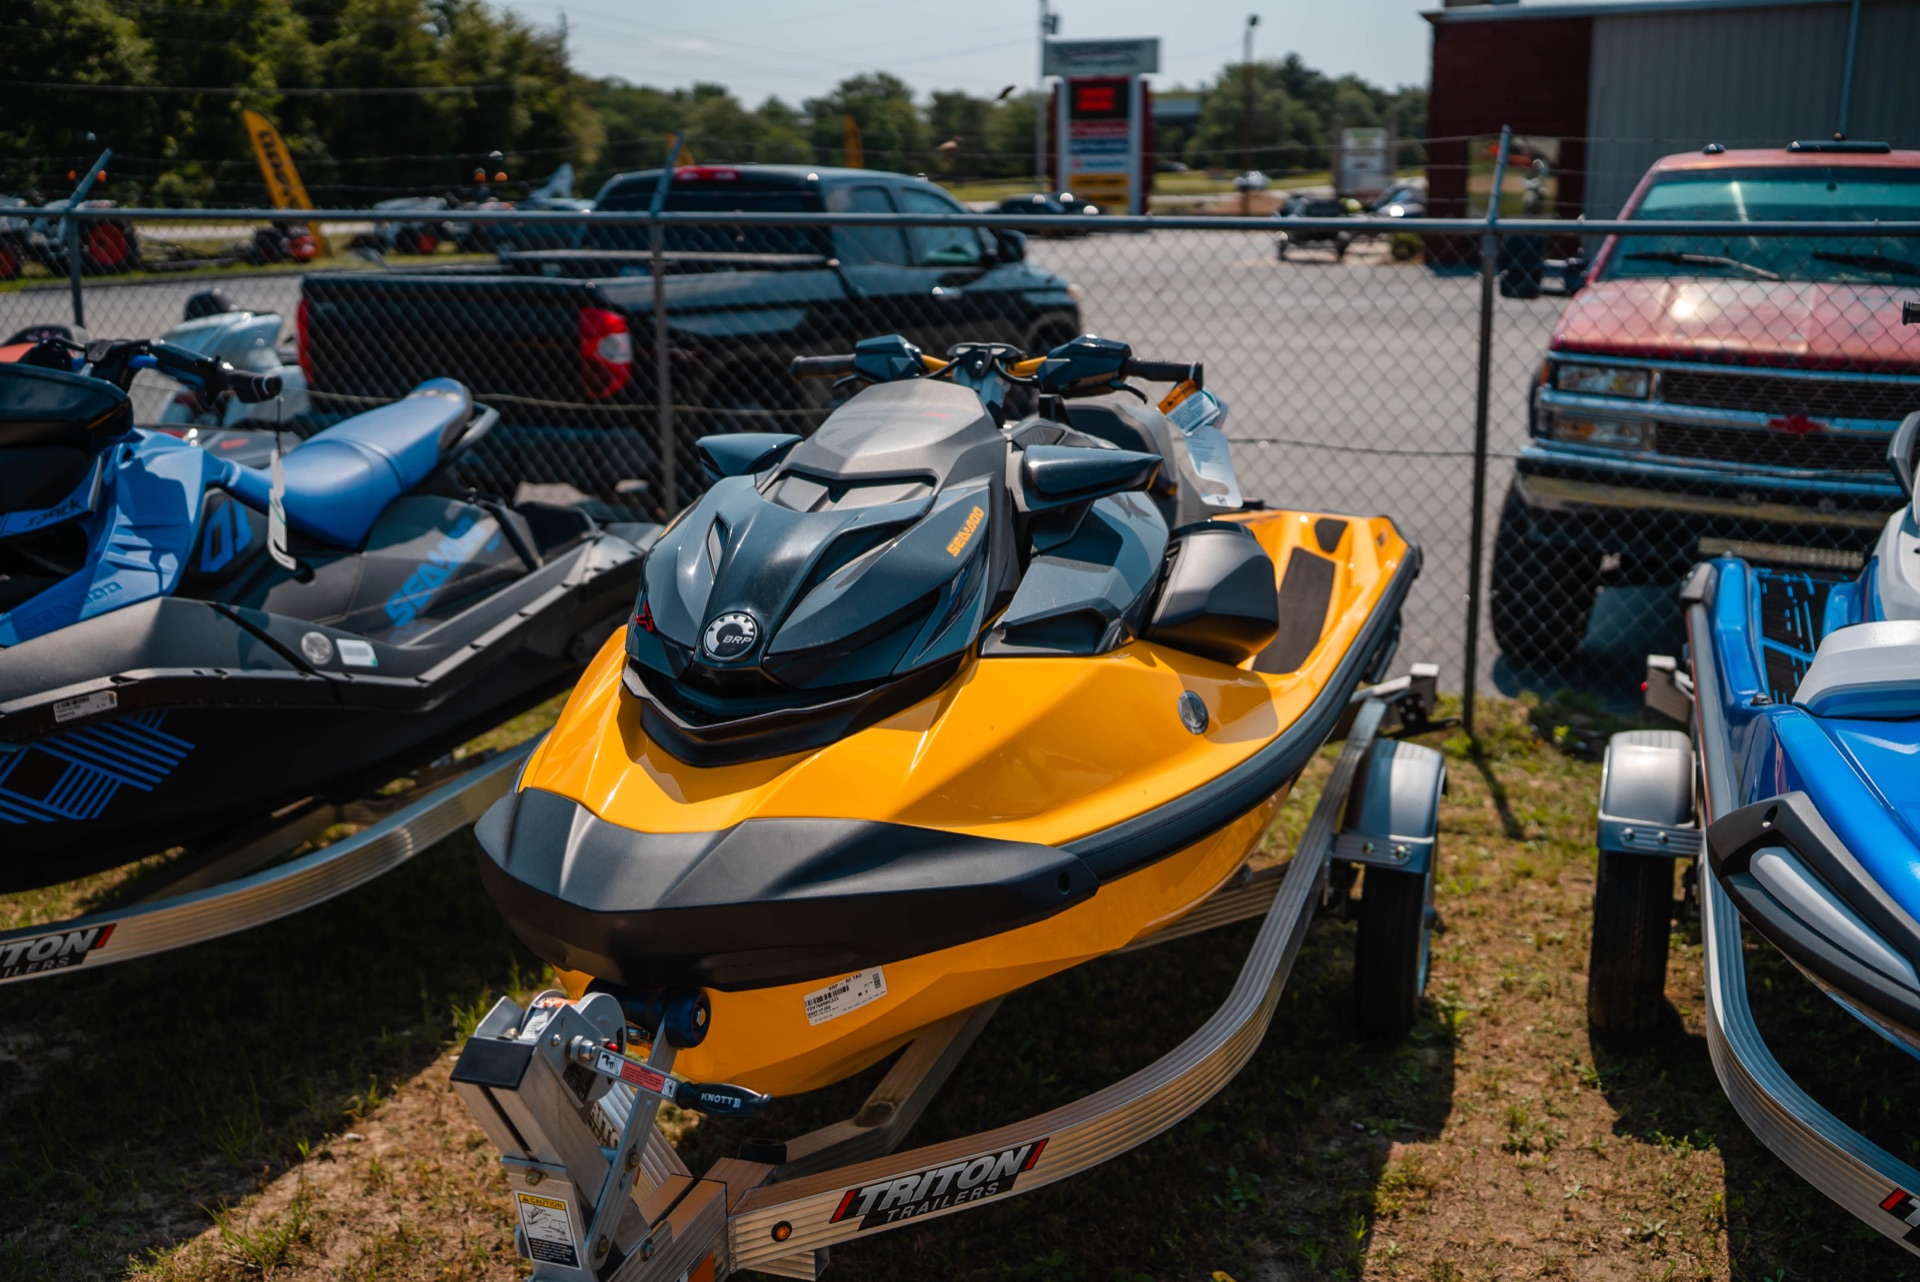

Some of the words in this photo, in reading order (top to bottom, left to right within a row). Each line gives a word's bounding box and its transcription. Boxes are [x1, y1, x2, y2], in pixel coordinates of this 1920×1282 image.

[722, 634, 753, 645] BRP
[0, 928, 99, 967] TON
[700, 1092, 734, 1105] KNOTT
[856, 1144, 1033, 1216] TRITON
[530, 1197, 564, 1209] CAUTION
[887, 1181, 999, 1223] TRAILERS
